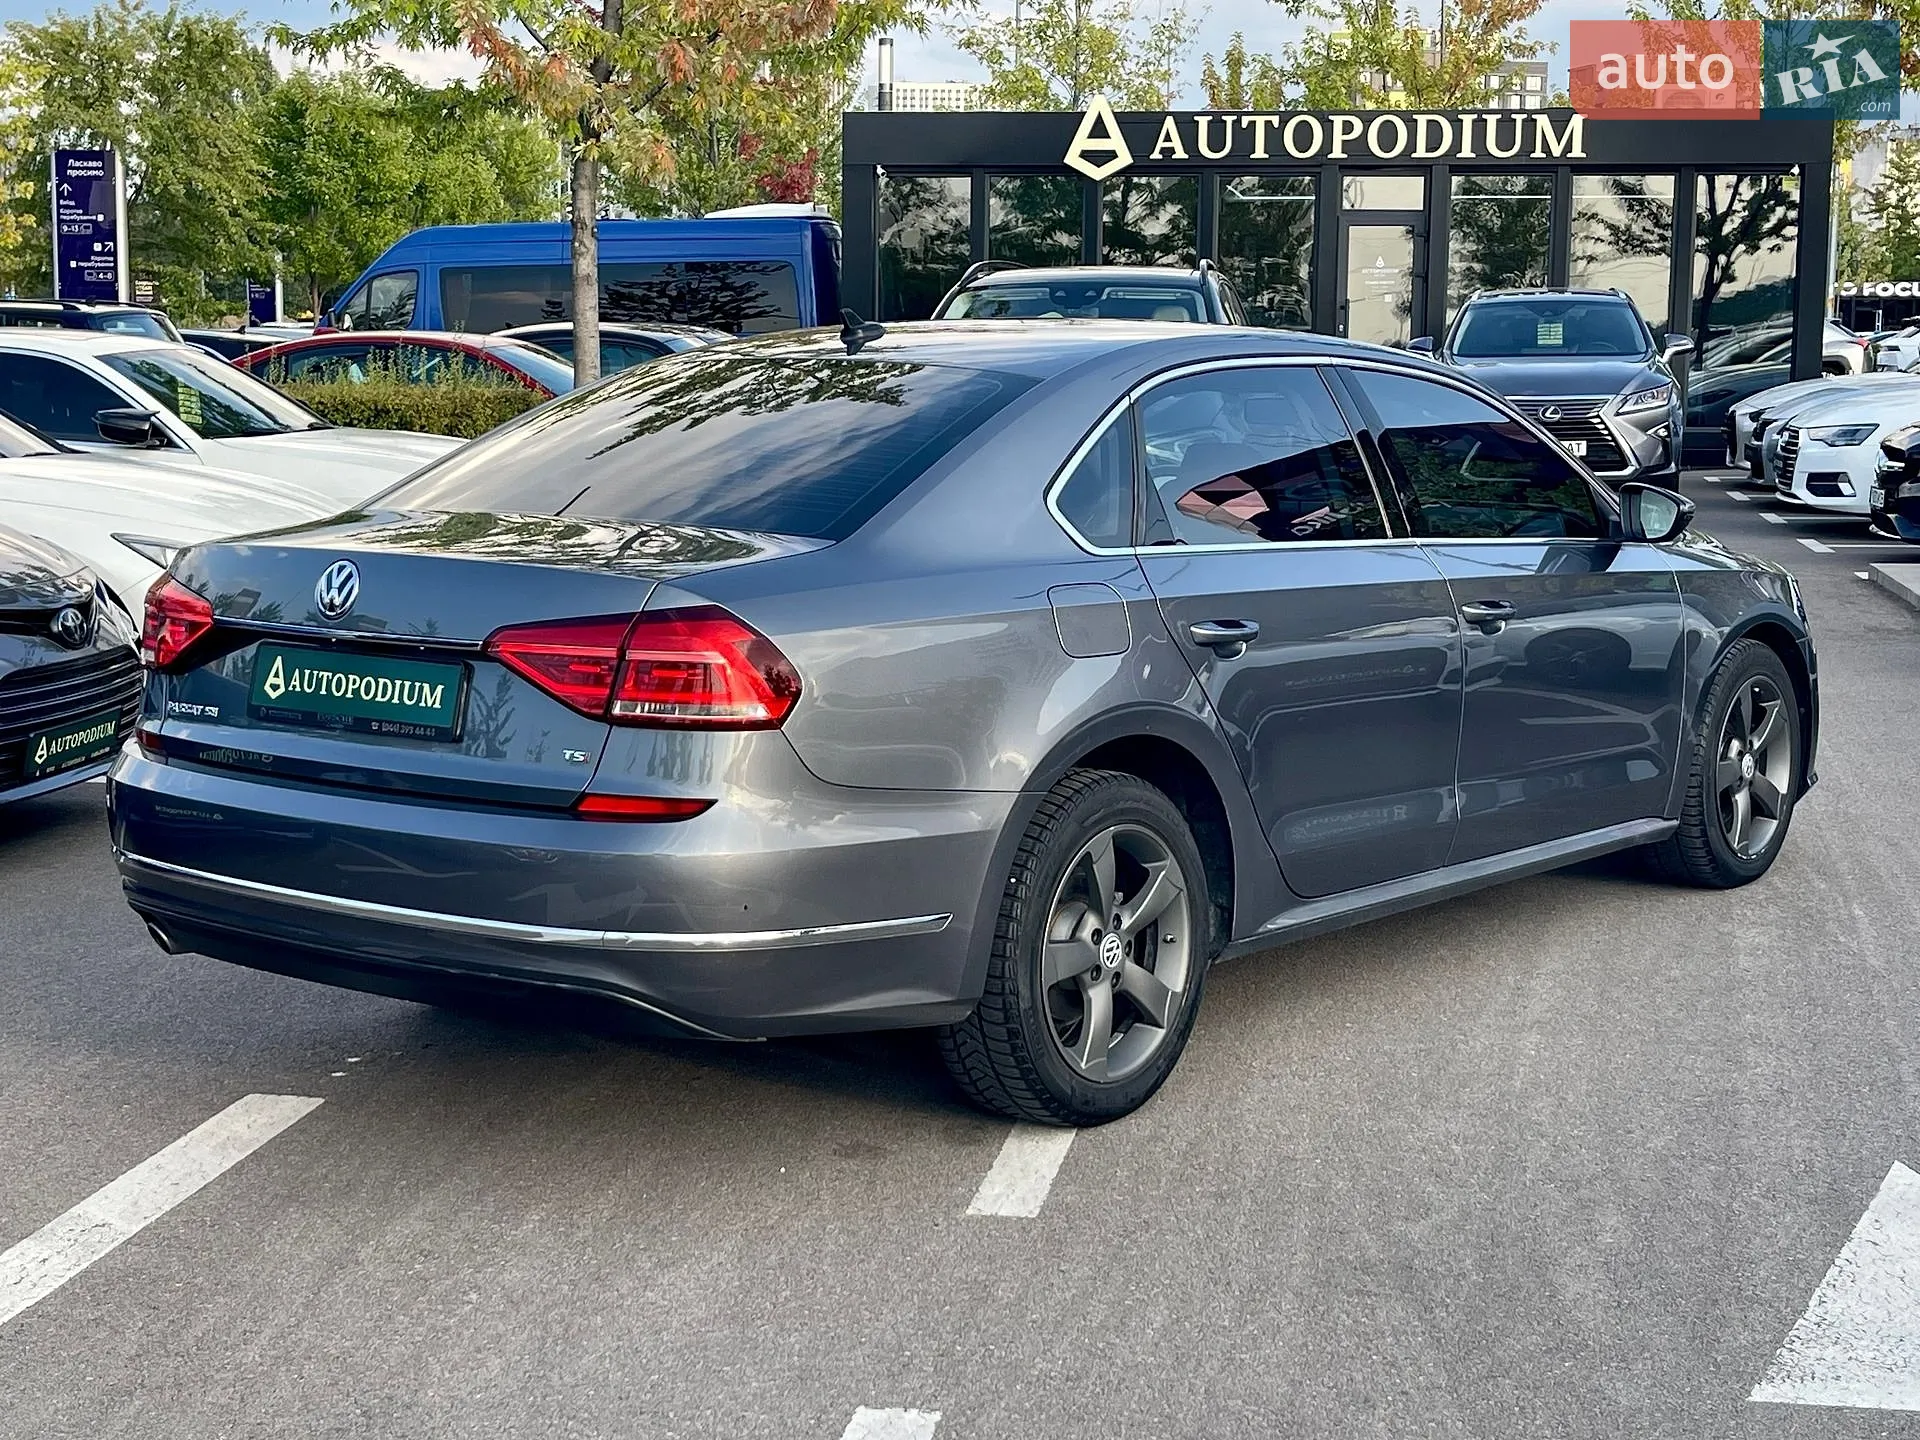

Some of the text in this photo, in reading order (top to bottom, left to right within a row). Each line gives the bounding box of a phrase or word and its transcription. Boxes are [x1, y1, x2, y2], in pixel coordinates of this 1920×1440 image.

[1149, 113, 1587, 160] AUTOPODIUM
[66, 169, 105, 178] просимо
[67, 158, 103, 168] Ласкаво
[287, 667, 445, 709] AUTOPODIUM
[167, 700, 204, 716] PASSAT
[48, 720, 116, 756] AUTOPODIUM
